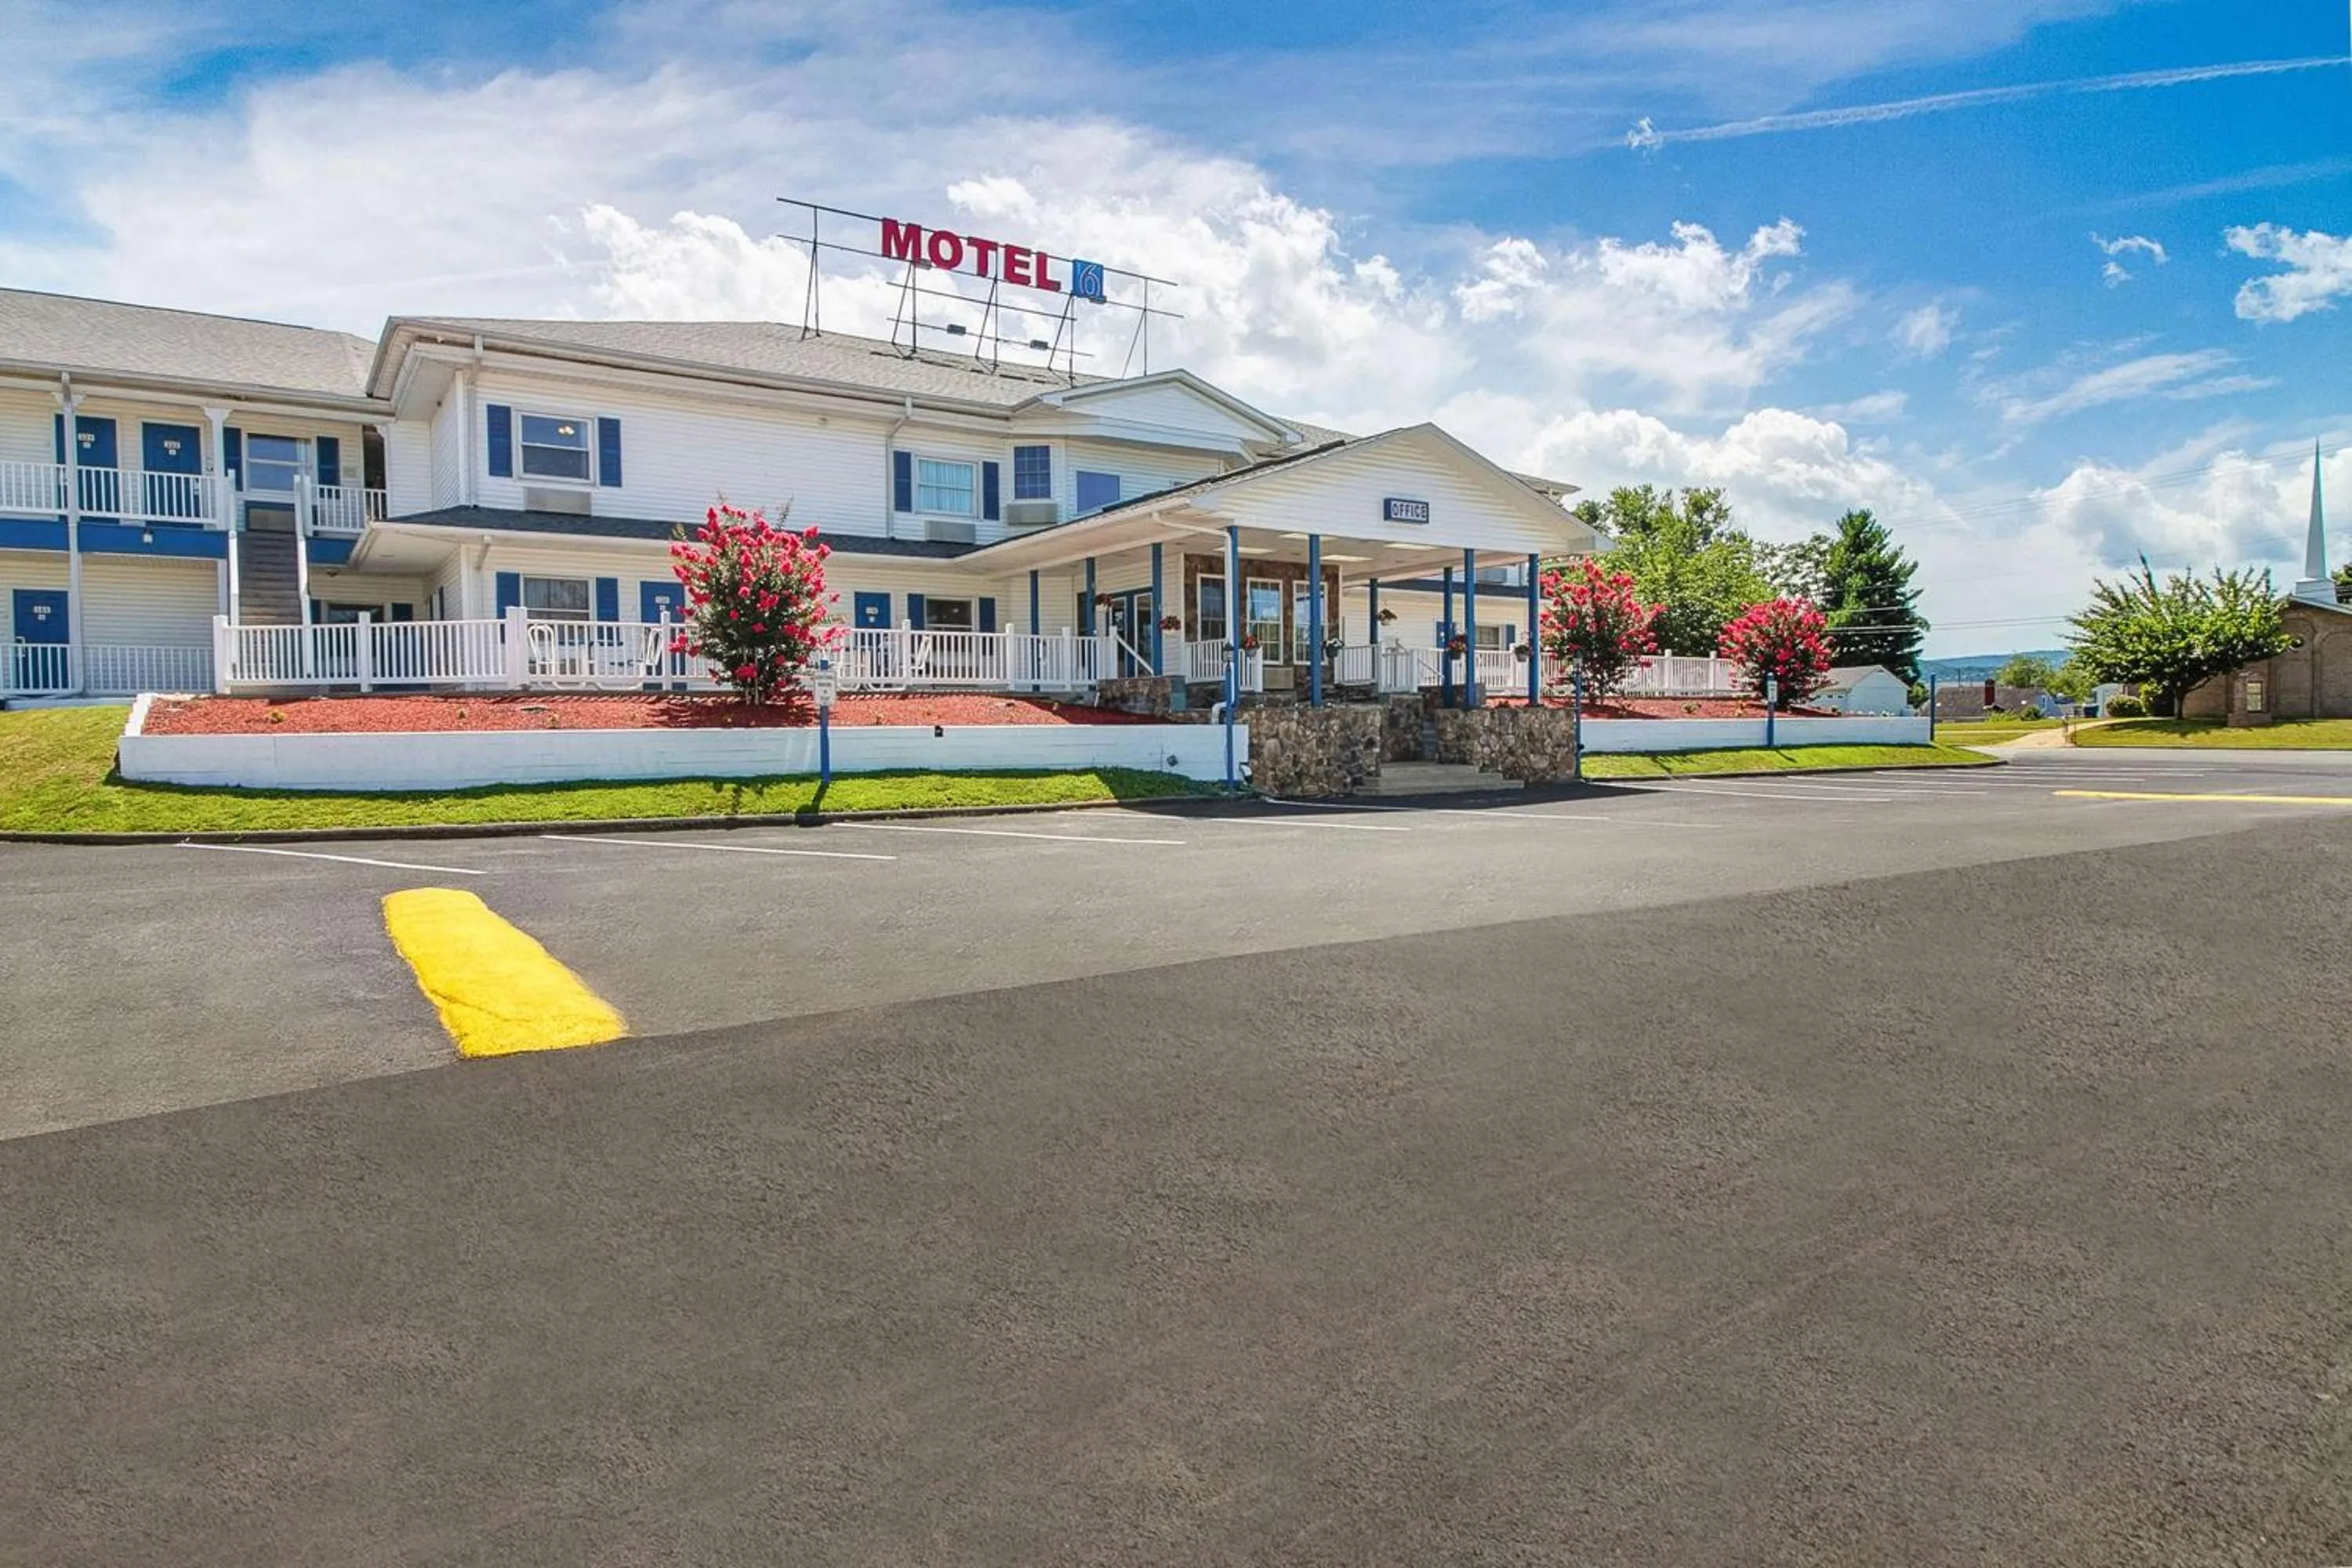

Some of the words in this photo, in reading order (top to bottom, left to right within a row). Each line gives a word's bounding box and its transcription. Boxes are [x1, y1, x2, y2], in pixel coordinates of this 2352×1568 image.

[881, 217, 1061, 292] MOTEL
[1080, 264, 1101, 296] 6
[1392, 503, 1427, 518] OFFICE
